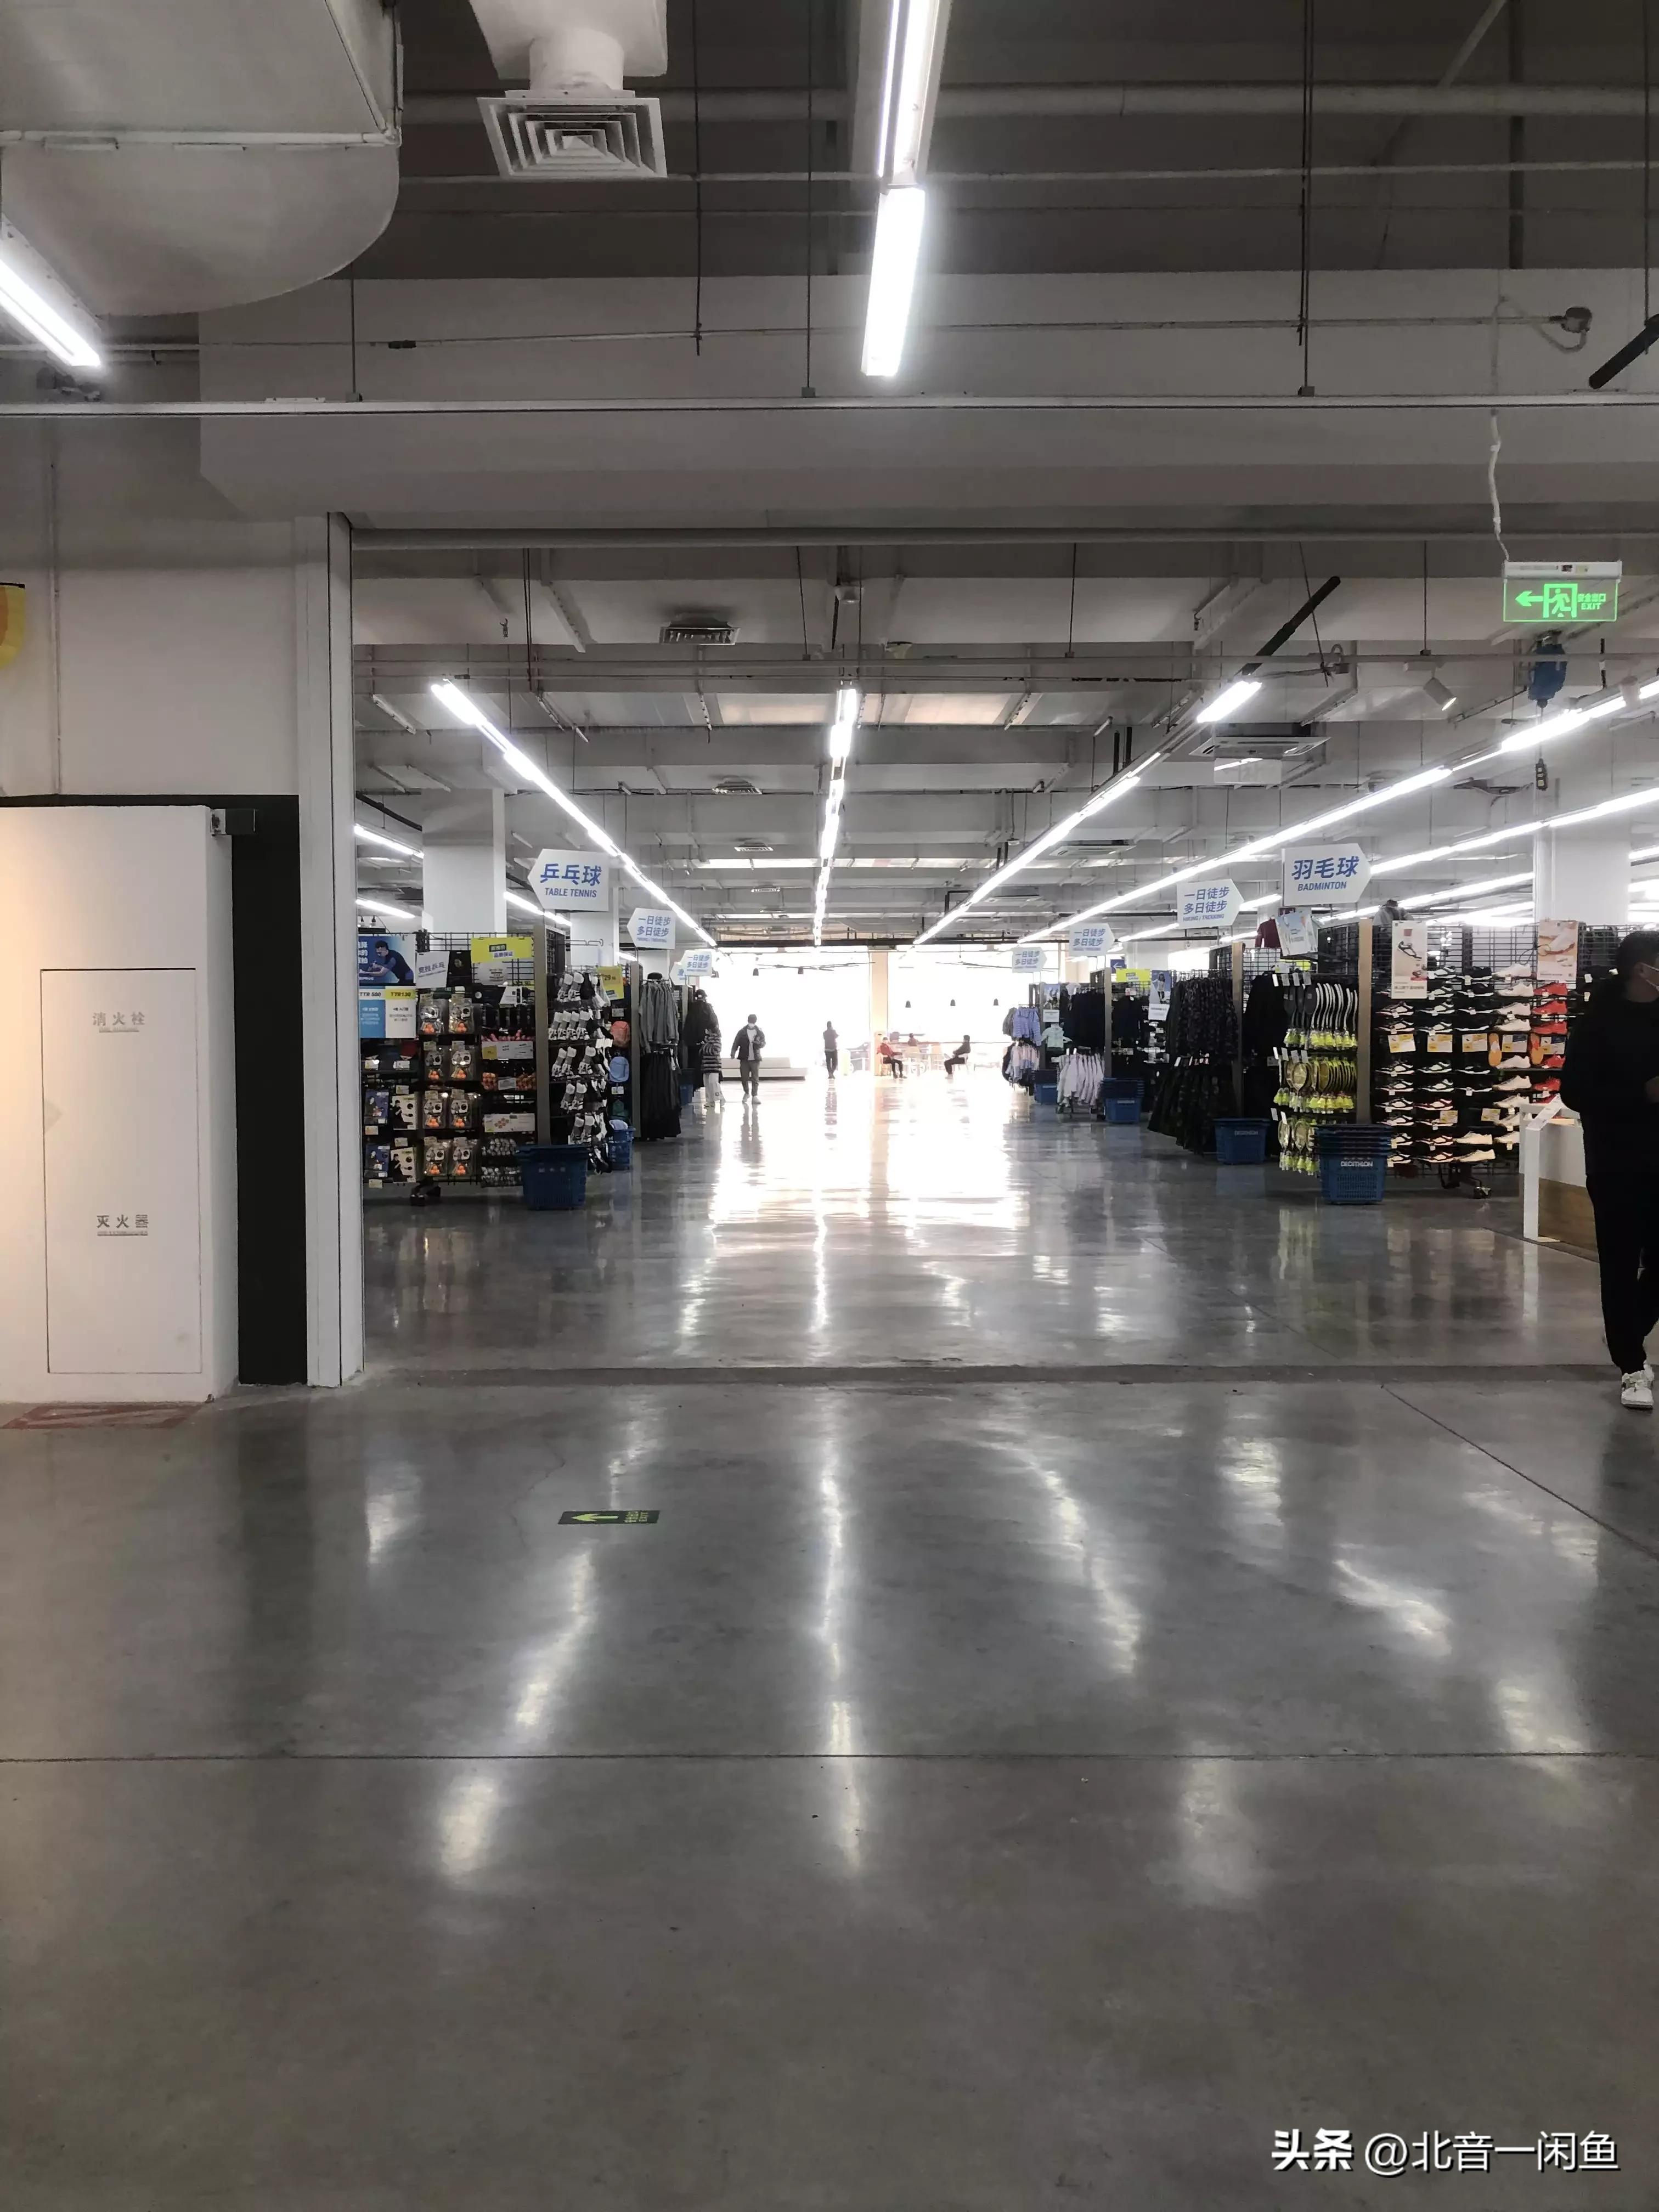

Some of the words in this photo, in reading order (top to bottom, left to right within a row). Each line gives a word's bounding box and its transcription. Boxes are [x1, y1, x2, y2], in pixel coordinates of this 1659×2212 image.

[1291, 856, 1360, 880] 羽毛球
[540, 863, 602, 887] 乒乓球
[1298, 881, 1347, 891] BADMINTON
[545, 887, 568, 896] TABLE
[571, 889, 597, 898] TENNIS
[1184, 886, 1230, 900] 一日徒步
[1183, 900, 1228, 915] 多日徒步
[638, 915, 671, 926] 一日徒步
[637, 926, 669, 937] 多日徒步
[1074, 928, 1105, 938] 一日徒步
[1073, 938, 1104, 946] 多日徒步
[92, 1012, 145, 1026] 消火栓
[97, 1214, 148, 1228] 灭火器
